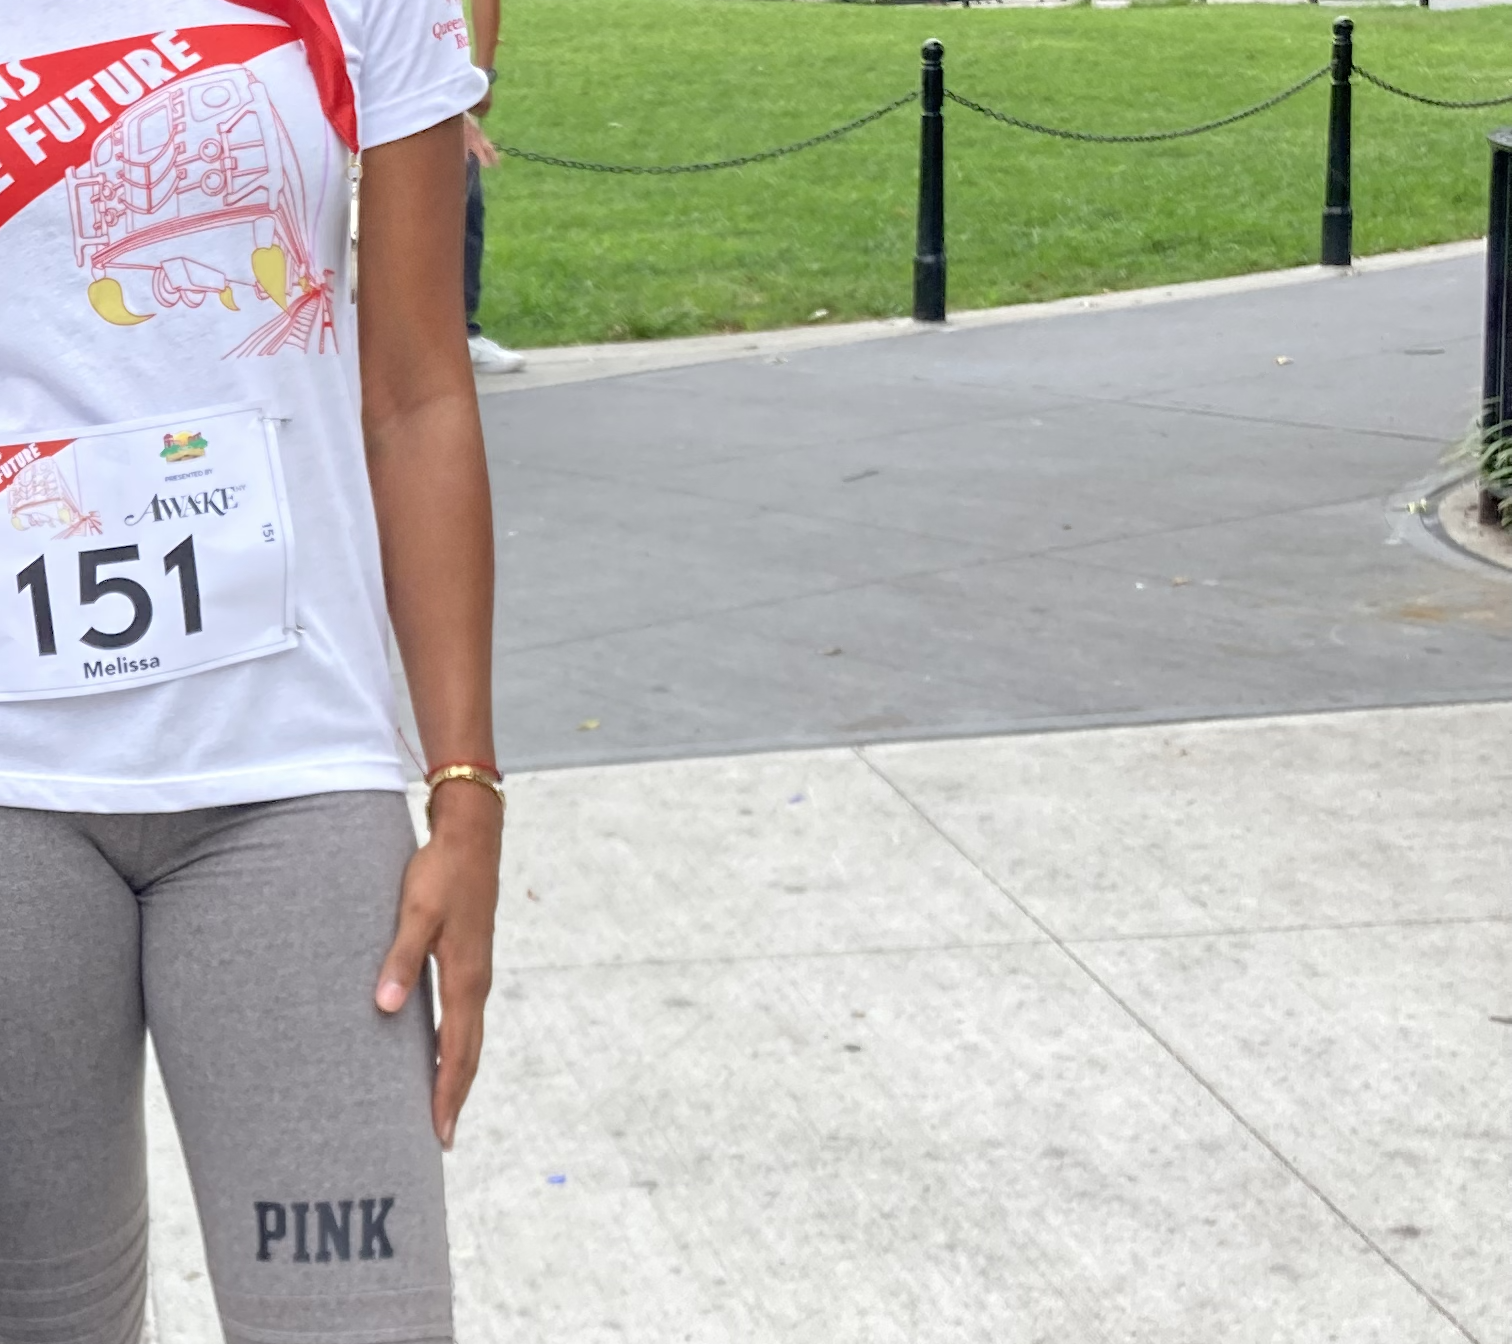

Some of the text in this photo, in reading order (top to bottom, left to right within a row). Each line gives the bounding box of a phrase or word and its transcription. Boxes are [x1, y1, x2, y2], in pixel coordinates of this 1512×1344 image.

[6, 29, 203, 166] FUTURE
[164, 468, 213, 482] PRESENTED BY
[123, 487, 239, 527] AWAKE
[262, 522, 275, 543] 151
[16, 534, 203, 656] 151
[83, 654, 161, 679] Melissa
[254, 1197, 396, 1264] PINK
